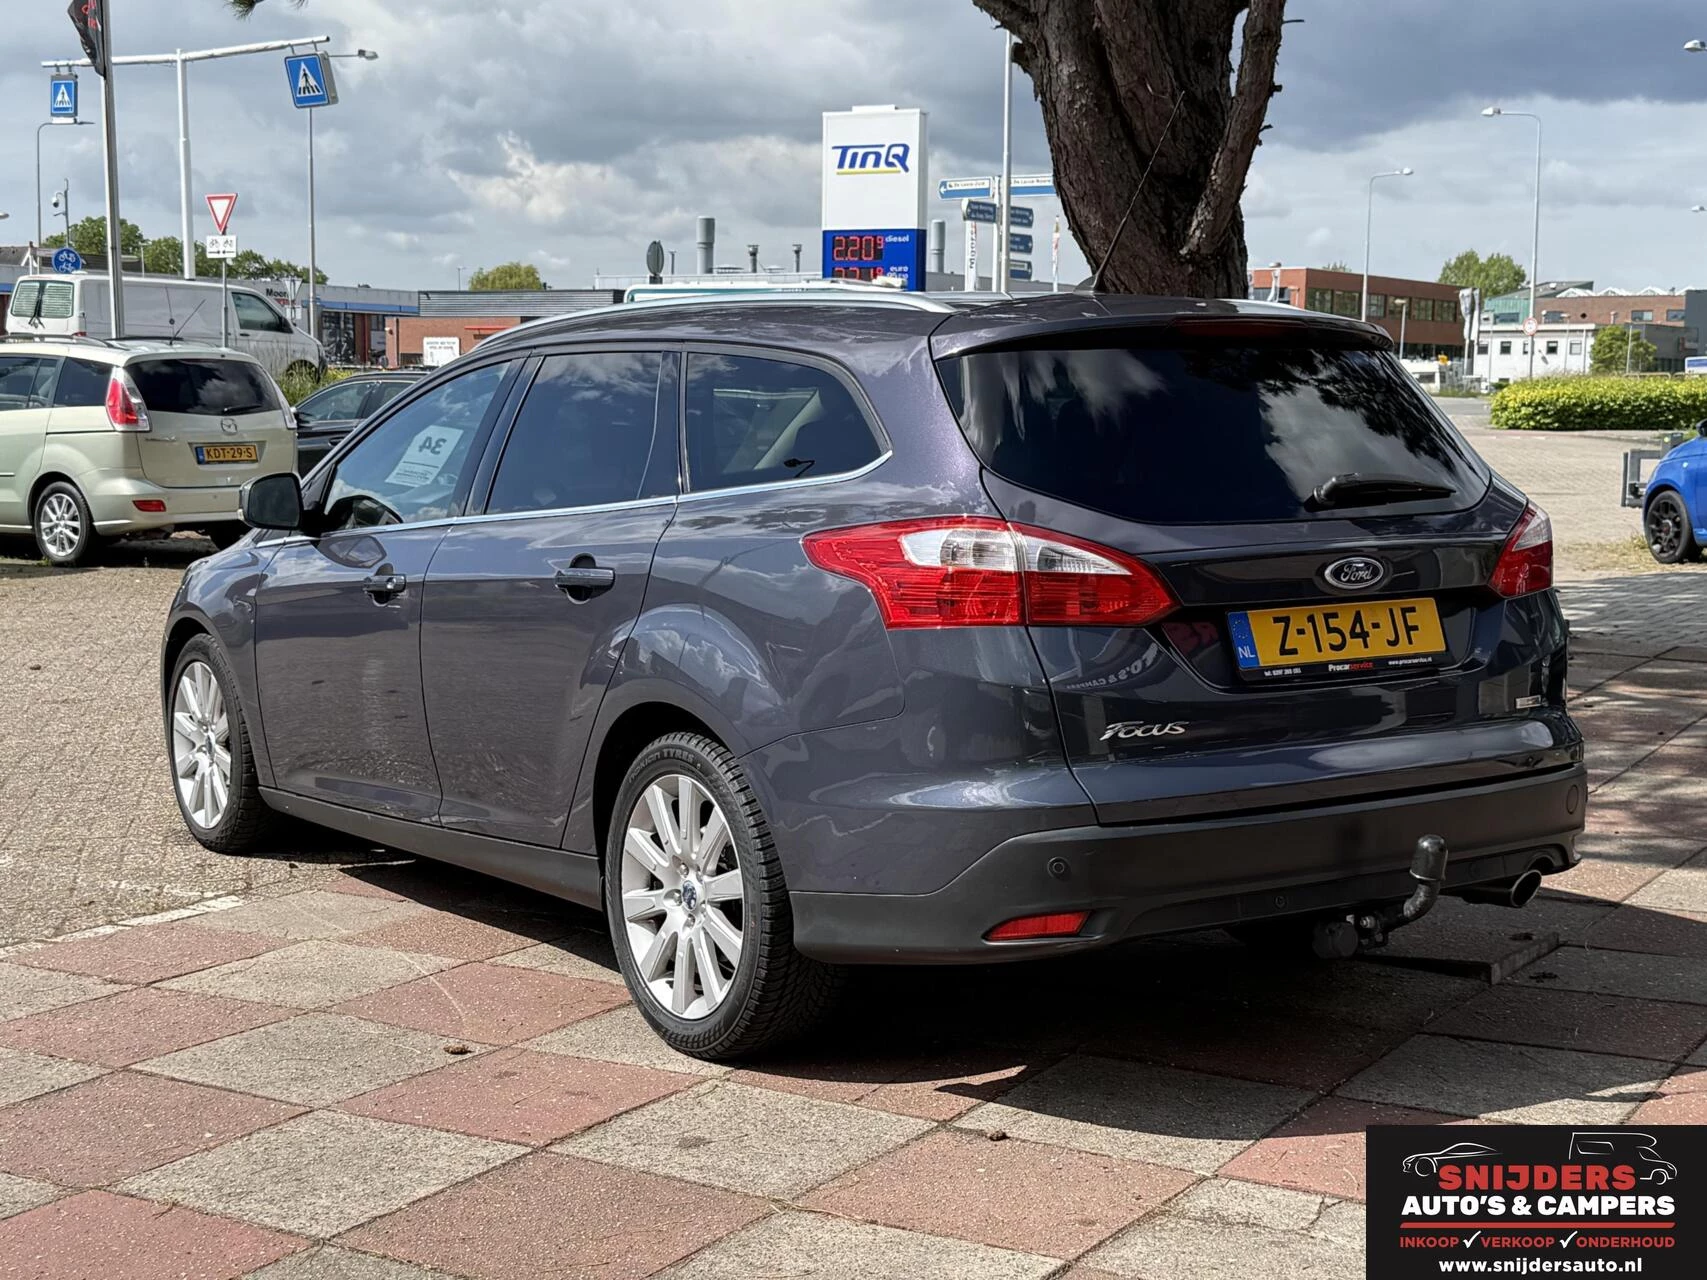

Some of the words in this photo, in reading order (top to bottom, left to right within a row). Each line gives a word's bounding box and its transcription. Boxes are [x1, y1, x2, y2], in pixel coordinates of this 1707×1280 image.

[885, 235, 910, 243] diesel
[206, 447, 253, 459] KDT-29-S
[1340, 563, 1374, 581] Ford
[1272, 606, 1419, 656] Z-154-JF
[1238, 646, 1256, 659] NL
[1328, 661, 1374, 672] Procarservice
[1099, 721, 1190, 741] Focus
